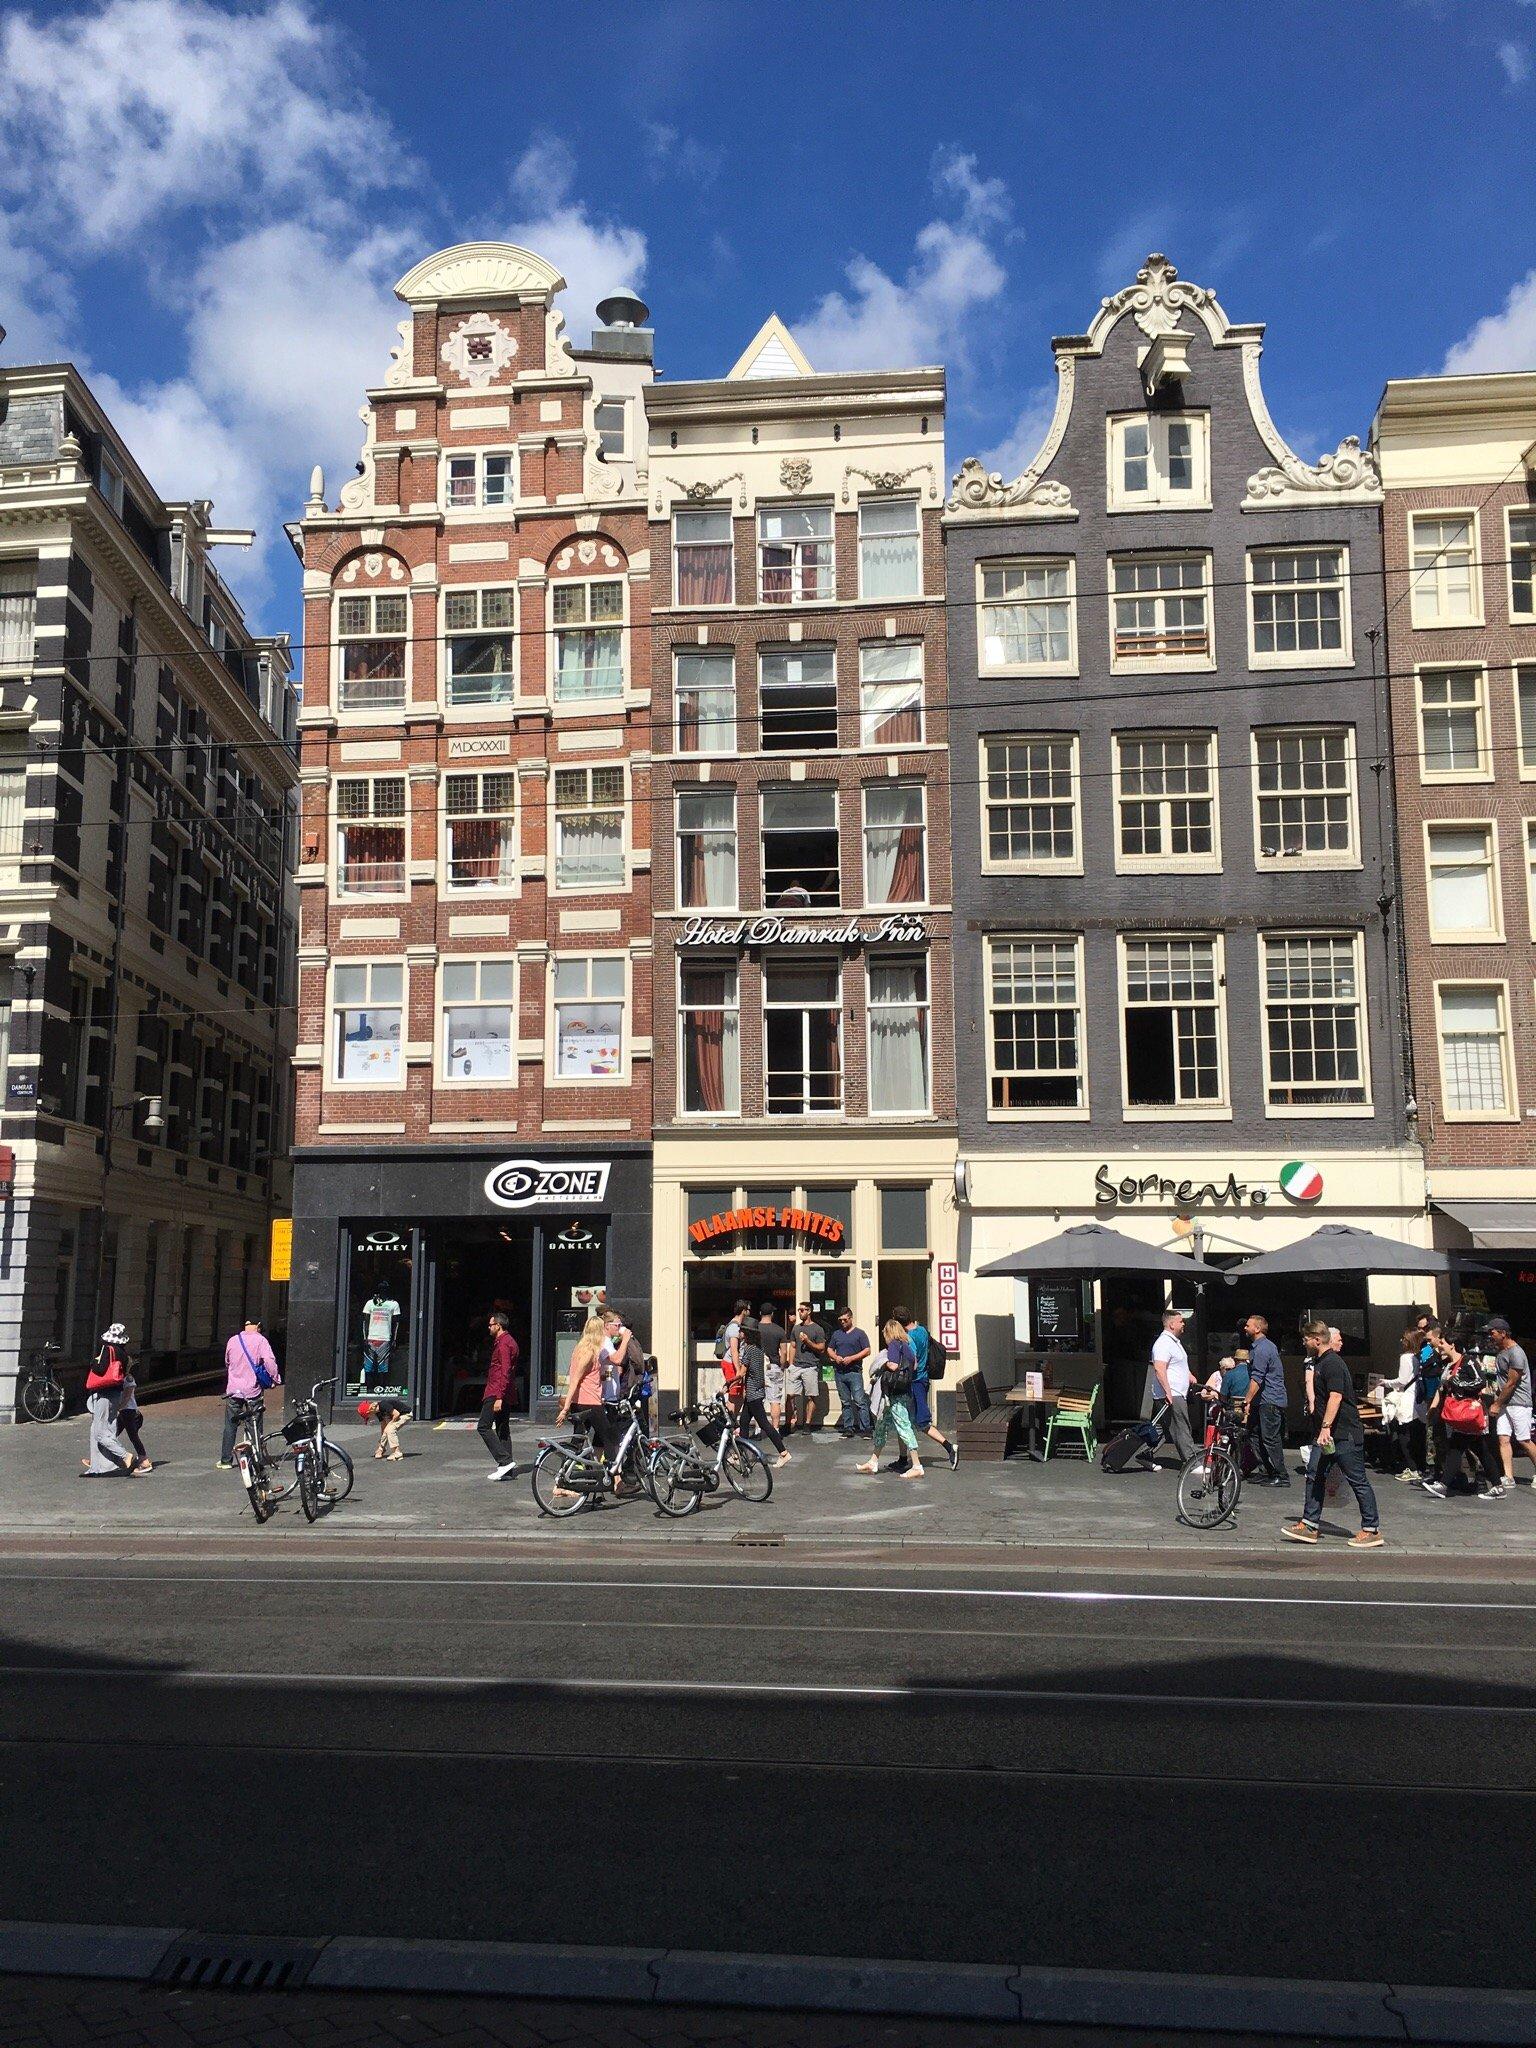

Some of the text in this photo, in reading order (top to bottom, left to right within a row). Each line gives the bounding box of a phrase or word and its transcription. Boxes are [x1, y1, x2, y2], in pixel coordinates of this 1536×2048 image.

[451, 740, 506, 753] MDCXXXII
[676, 914, 926, 945] Hotel Damrak Inn
[1095, 1164, 1268, 1205] Sorrento
[688, 1206, 844, 1243] VLAAMSE FRITES
[357, 1244, 408, 1252] OAKLEY
[548, 1242, 601, 1250] OAKLEY
[943, 1267, 953, 1346] HOTEL
